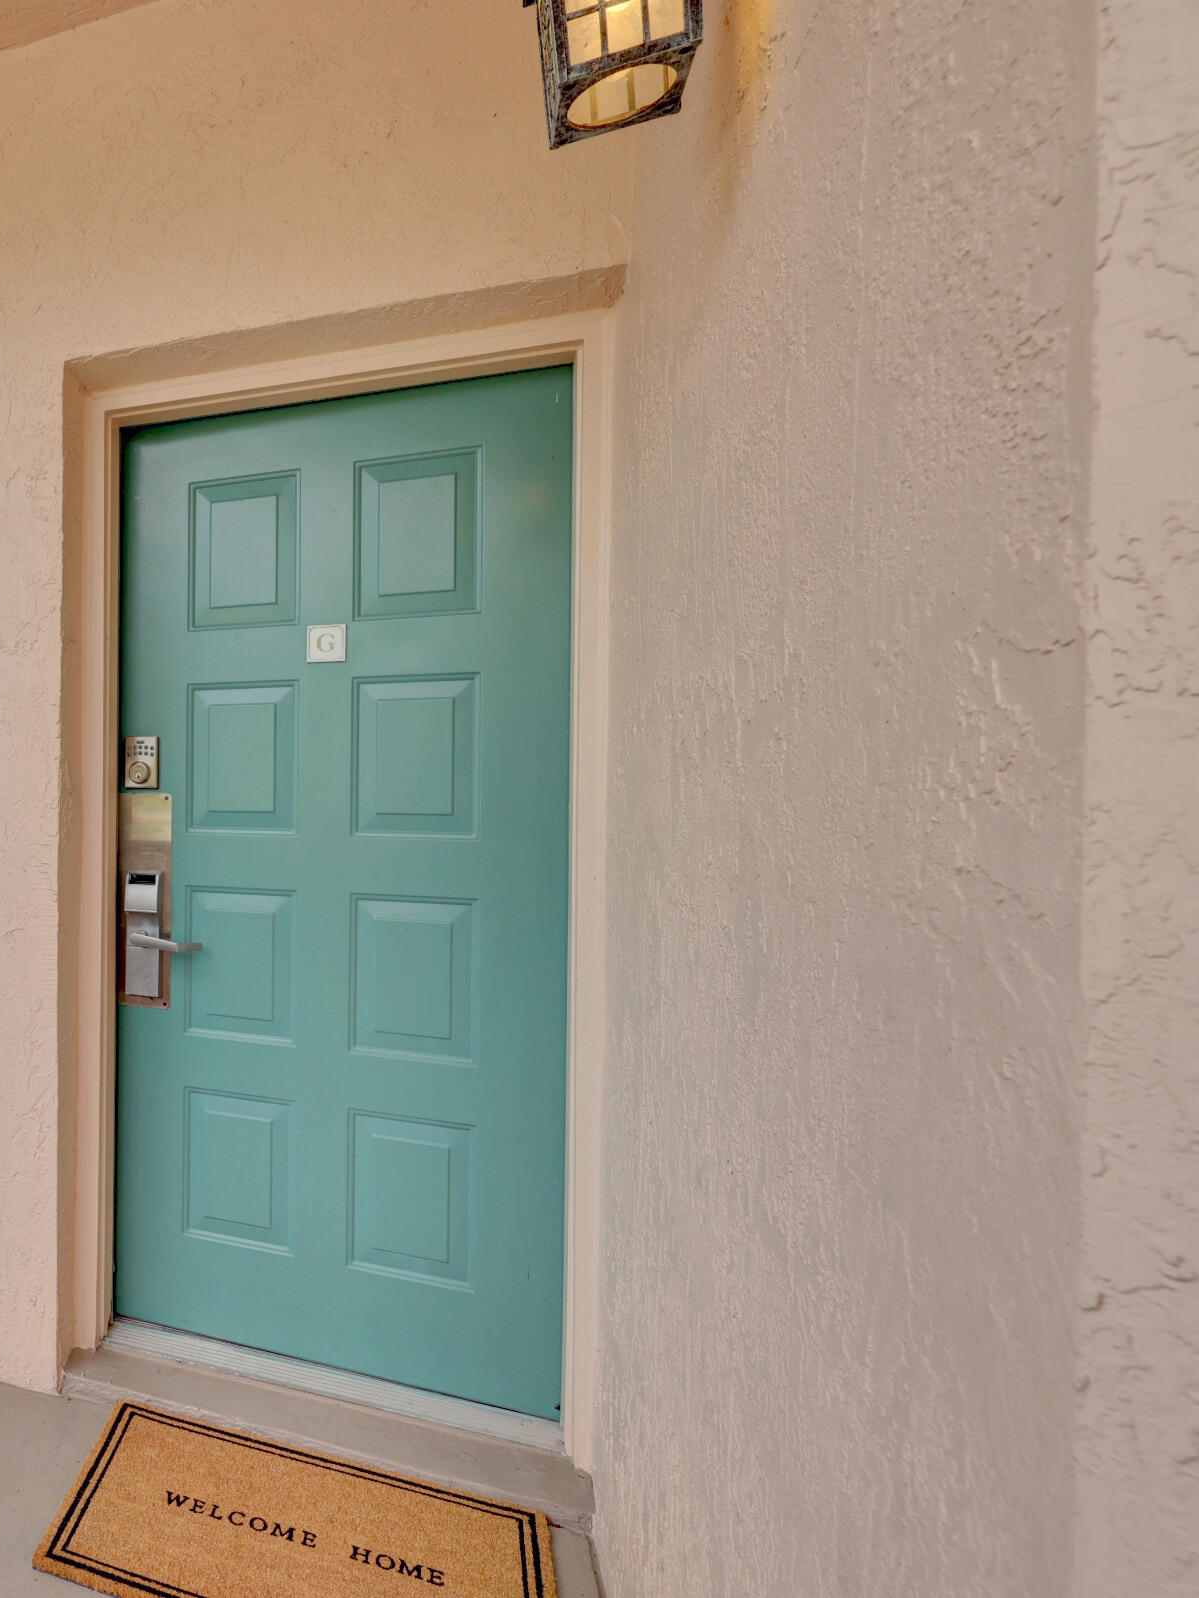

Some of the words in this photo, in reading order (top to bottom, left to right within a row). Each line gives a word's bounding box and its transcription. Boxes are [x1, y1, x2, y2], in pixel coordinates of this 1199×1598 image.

[316, 632, 335, 652] G
[166, 1490, 317, 1548] WELCOME
[350, 1545, 445, 1586] HOME
